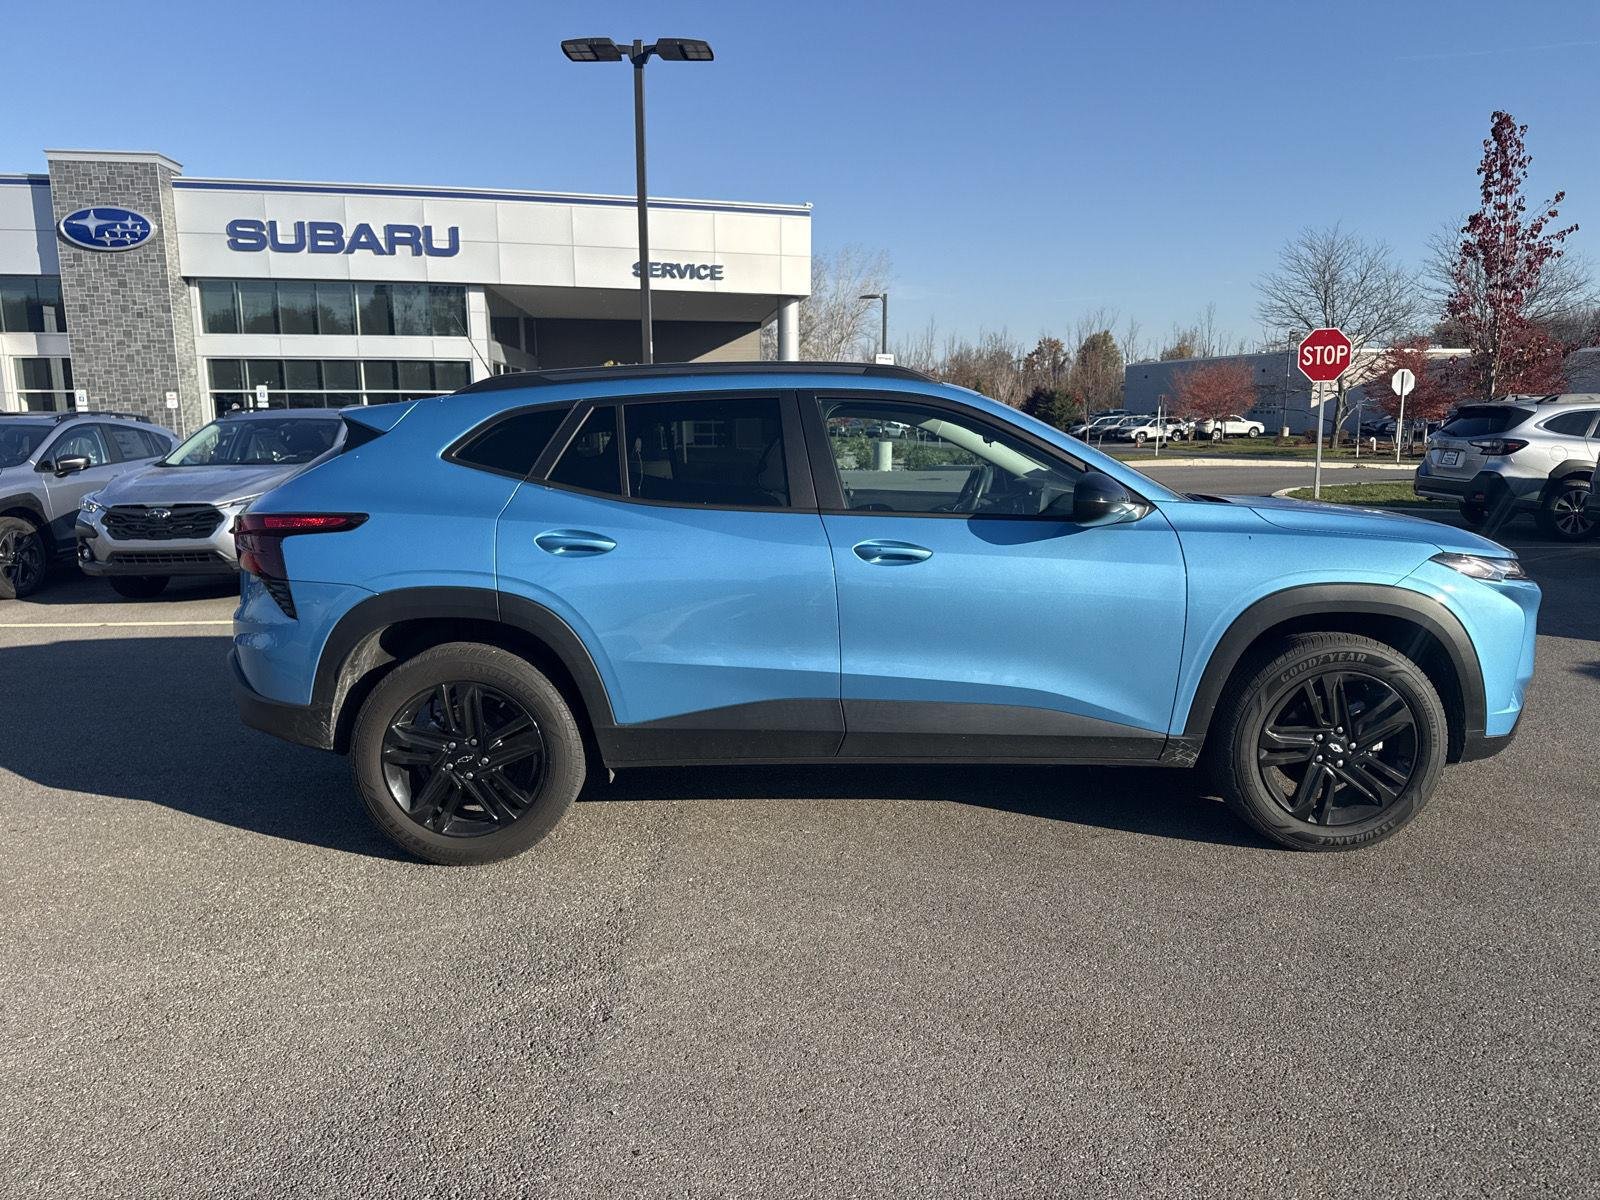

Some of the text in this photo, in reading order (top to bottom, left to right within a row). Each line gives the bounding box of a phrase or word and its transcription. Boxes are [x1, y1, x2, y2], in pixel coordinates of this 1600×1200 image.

[226, 219, 460, 258] SUBARU
[1302, 345, 1348, 366] STOP
[1280, 652, 1367, 682] GOODYEAR
